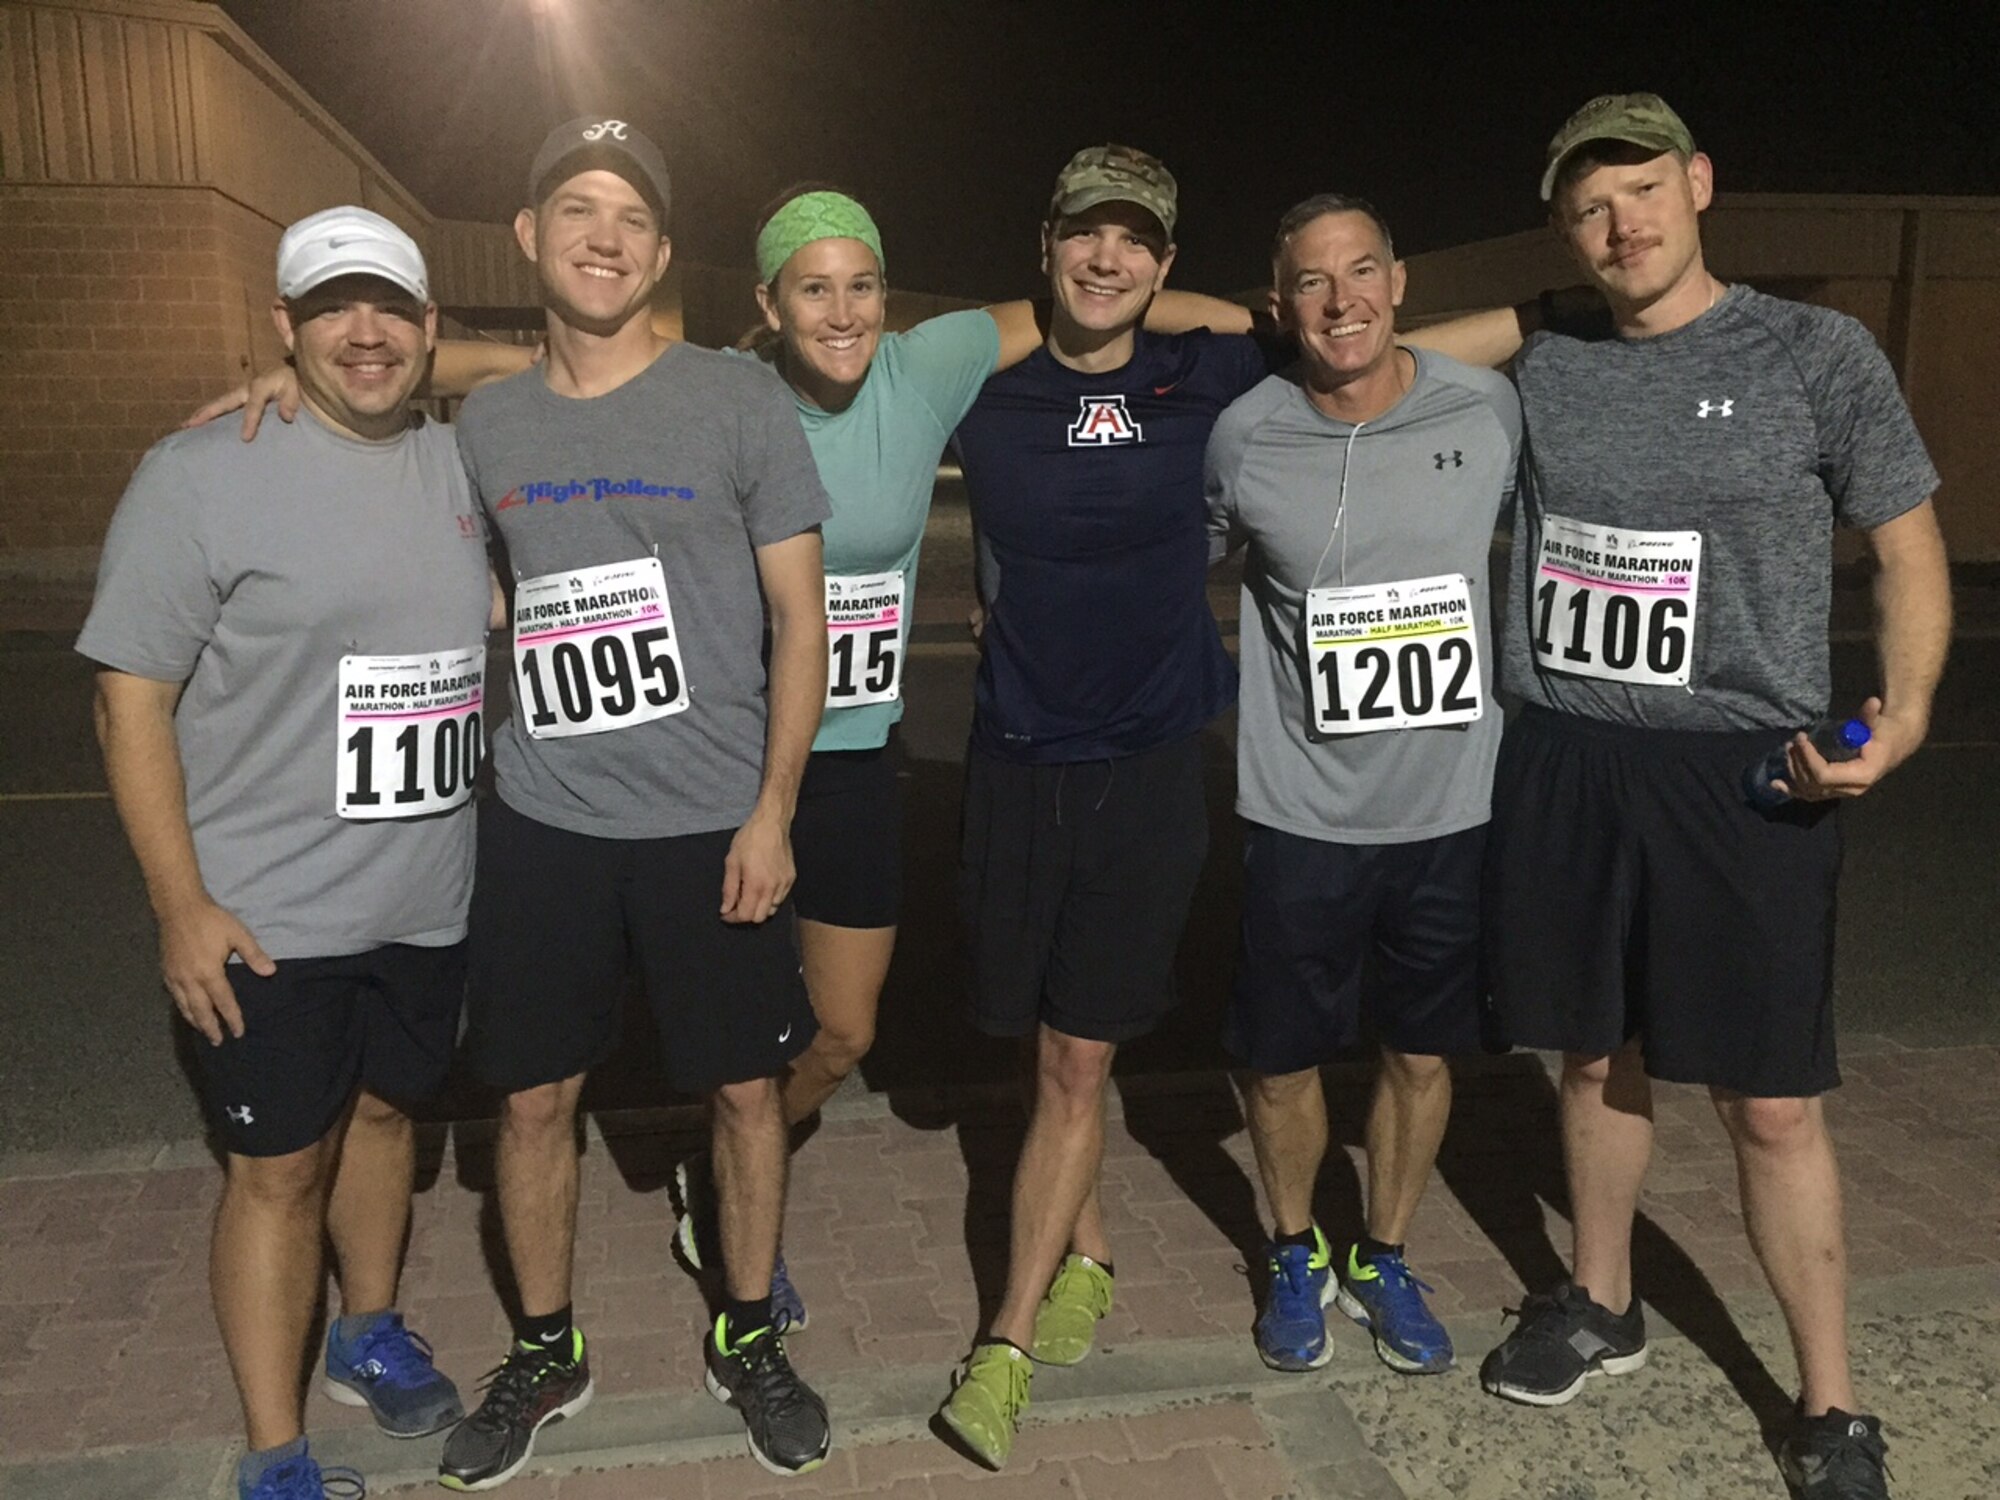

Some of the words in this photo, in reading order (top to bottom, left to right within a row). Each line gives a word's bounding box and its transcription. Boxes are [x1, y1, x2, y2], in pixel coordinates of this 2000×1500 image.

[1068, 395, 1142, 446] A
[520, 482, 587, 505] High
[586, 478, 695, 502] Rollers
[1543, 539, 1562, 556] AIR
[1565, 545, 1600, 566] FORCE
[1604, 554, 1693, 573] MARATHON
[1546, 557, 1581, 572] MARATHON
[1586, 568, 1606, 579] HALF
[1608, 572, 1659, 585] MARATHON
[1668, 576, 1687, 585] 10K
[517, 607, 532, 623] AIR
[534, 601, 571, 619] FORCE
[574, 586, 660, 613] MARATHON
[829, 594, 899, 612] MARATHON
[832, 612, 876, 622] MARATHON
[1311, 614, 1335, 627] AIR
[1340, 609, 1384, 625] FORCE
[1389, 599, 1467, 621] MARATHON
[519, 621, 554, 635] MARATHON
[560, 618, 581, 629] HALF
[583, 608, 632, 625] MARATHON
[641, 603, 660, 615] 10K
[1316, 628, 1363, 639] MARATHON
[1370, 624, 1392, 635] HALF
[1394, 619, 1442, 632] MARATHON
[1449, 616, 1465, 625] 10K
[1535, 579, 1688, 674] 1106
[345, 684, 375, 699] AIR
[380, 682, 426, 699] FORCE
[430, 671, 482, 695] MARATHON
[522, 627, 680, 727] 1095
[1317, 637, 1477, 721] 1202
[350, 702, 405, 712] MARATHON
[413, 699, 432, 710] HALF
[434, 692, 468, 706] MARATHON
[346, 711, 481, 806] 1100
